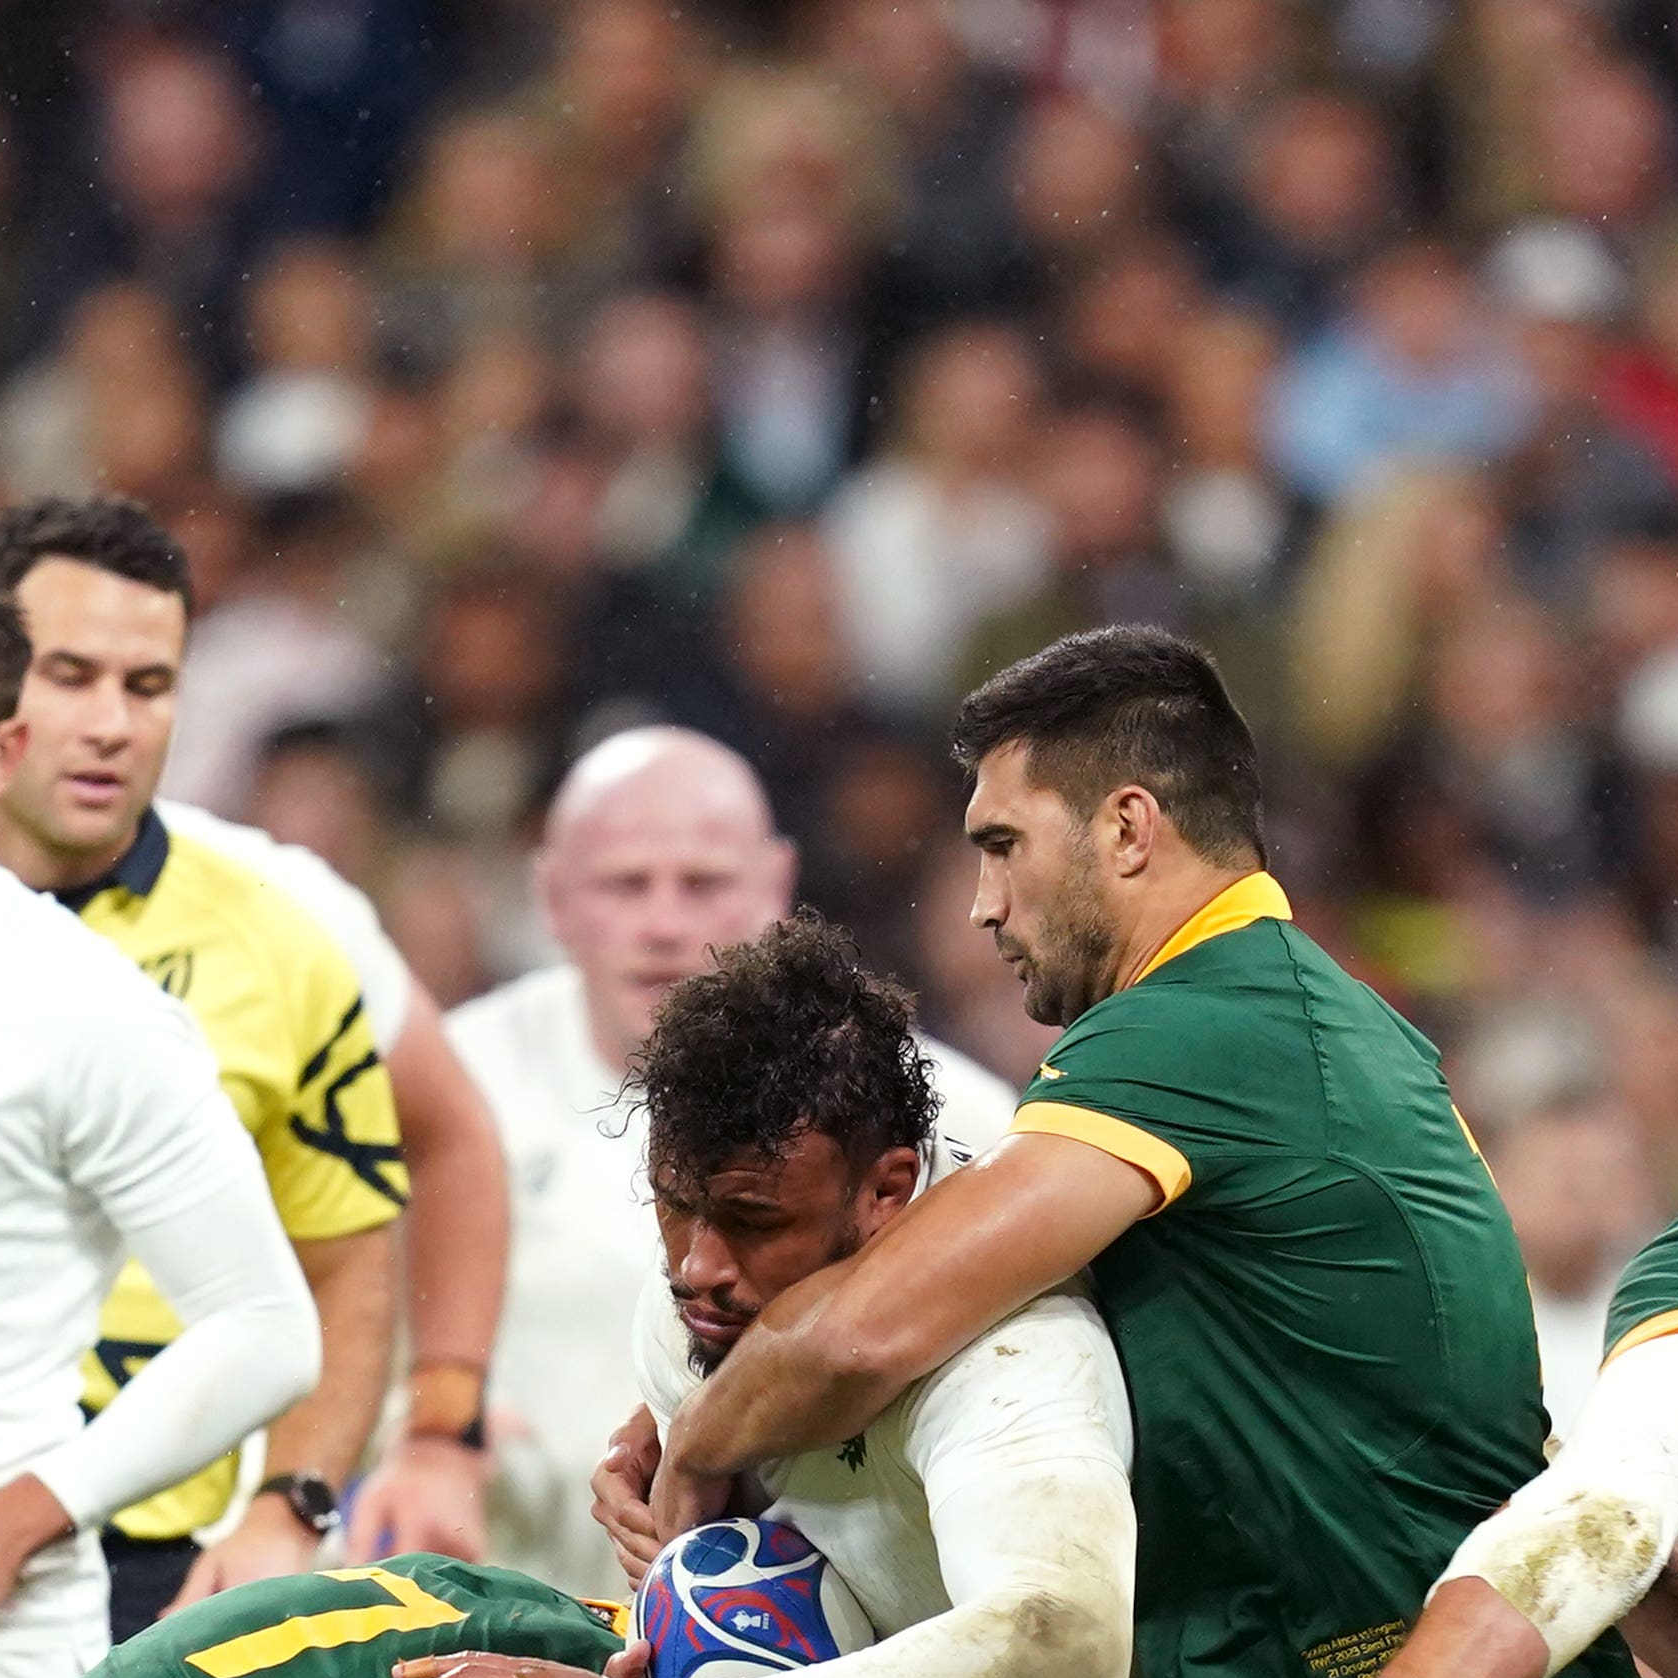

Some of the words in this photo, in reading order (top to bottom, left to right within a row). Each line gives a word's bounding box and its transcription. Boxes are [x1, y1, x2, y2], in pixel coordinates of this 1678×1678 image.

[1335, 1646, 1360, 1661] 2023
[1360, 1638, 1386, 1654] Semi
[1340, 1657, 1377, 1676] October
